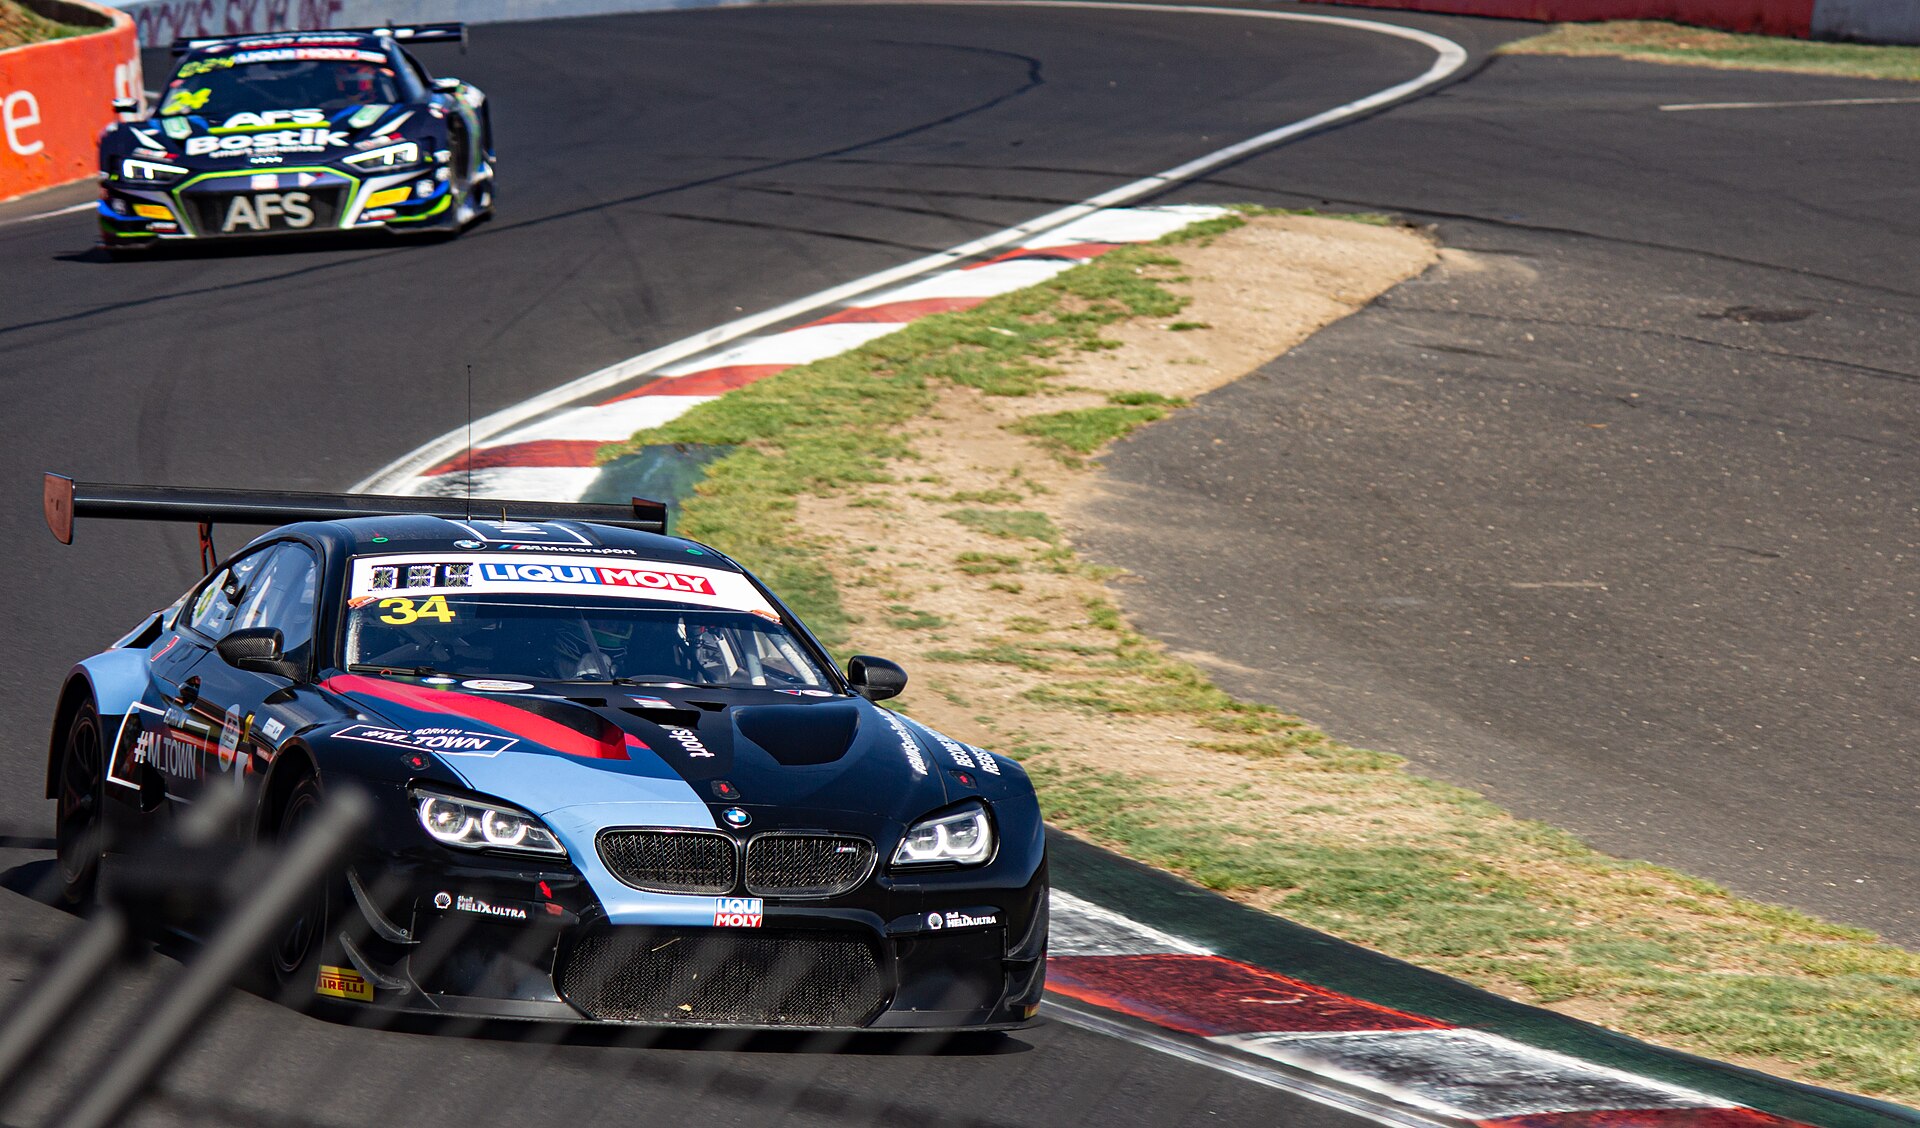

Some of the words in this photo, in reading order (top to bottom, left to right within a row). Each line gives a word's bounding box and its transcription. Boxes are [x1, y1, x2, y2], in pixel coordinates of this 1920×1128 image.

[0, 90, 45, 155] e
[223, 107, 325, 129] AFS
[186, 128, 350, 156] Bostik
[221, 191, 315, 233] AFS
[542, 545, 637, 555] Motorsport
[483, 563, 598, 584] LIQUI
[599, 568, 707, 594] MOLY
[378, 595, 456, 625] 34
[668, 728, 716, 758] sport
[492, 905, 527, 919] ULTRA
[716, 898, 762, 914] LIQUI
[715, 914, 762, 928] MOLY
